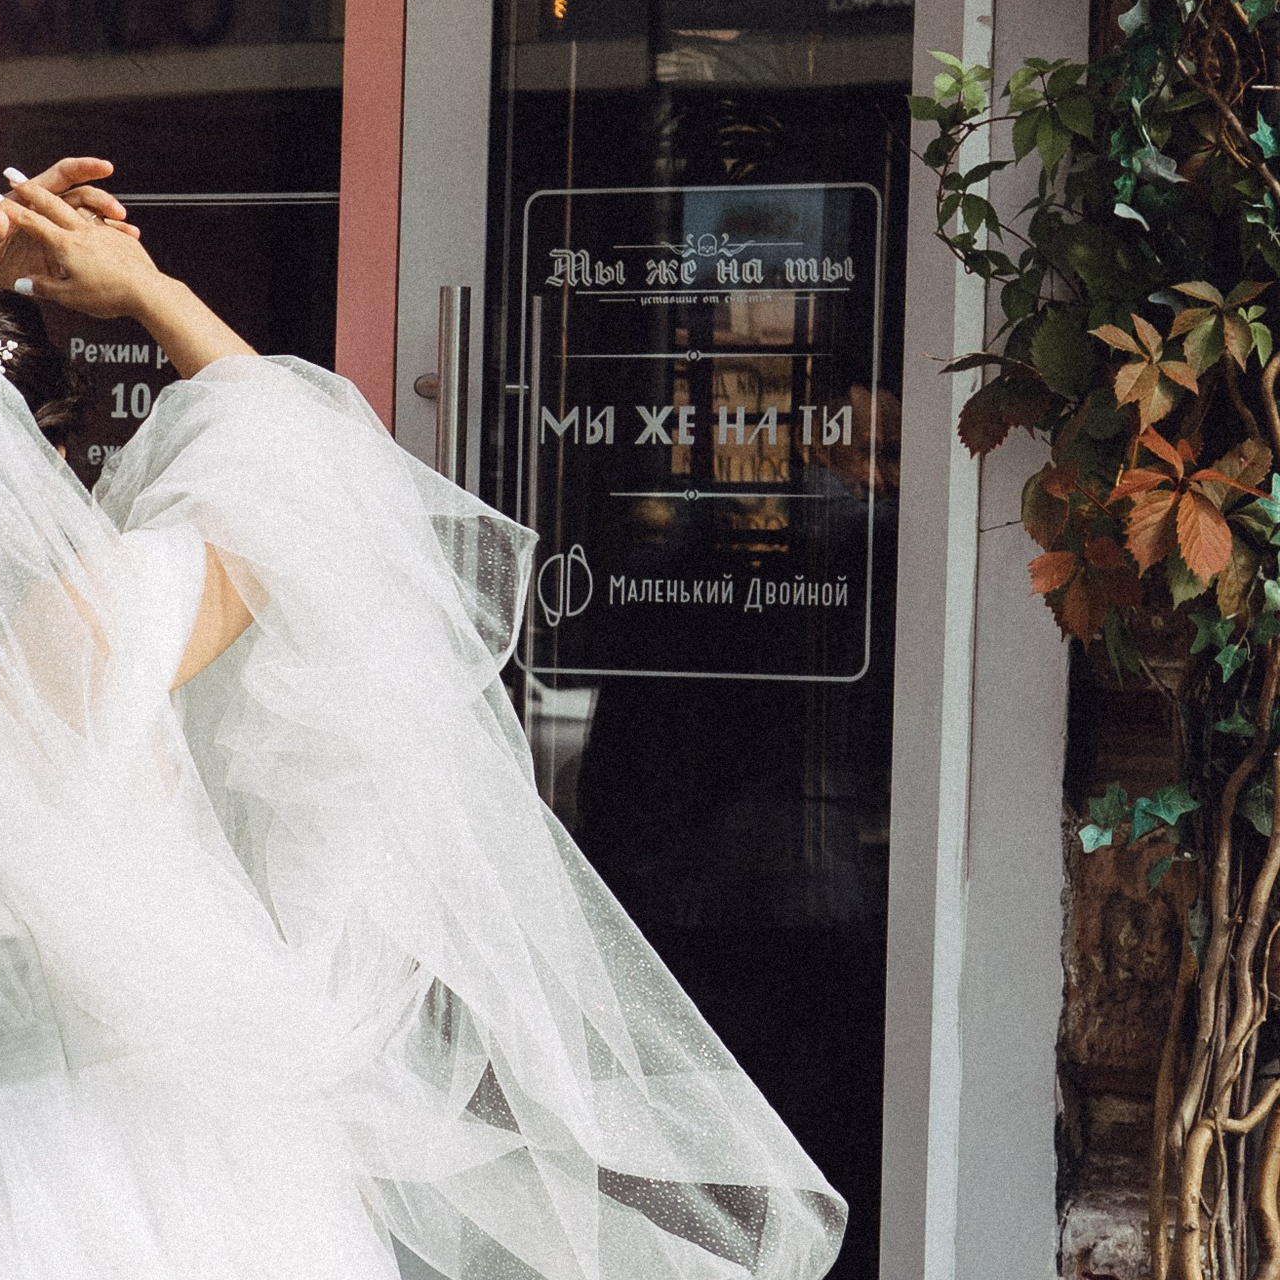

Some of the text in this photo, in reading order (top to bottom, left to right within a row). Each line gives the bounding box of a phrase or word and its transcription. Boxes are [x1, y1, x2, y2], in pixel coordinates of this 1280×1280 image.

[70, 337, 150, 364] Режим
[634, 405, 696, 446] ЖЕ
[718, 405, 778, 446] НА
[798, 405, 853, 446] ТЫ
